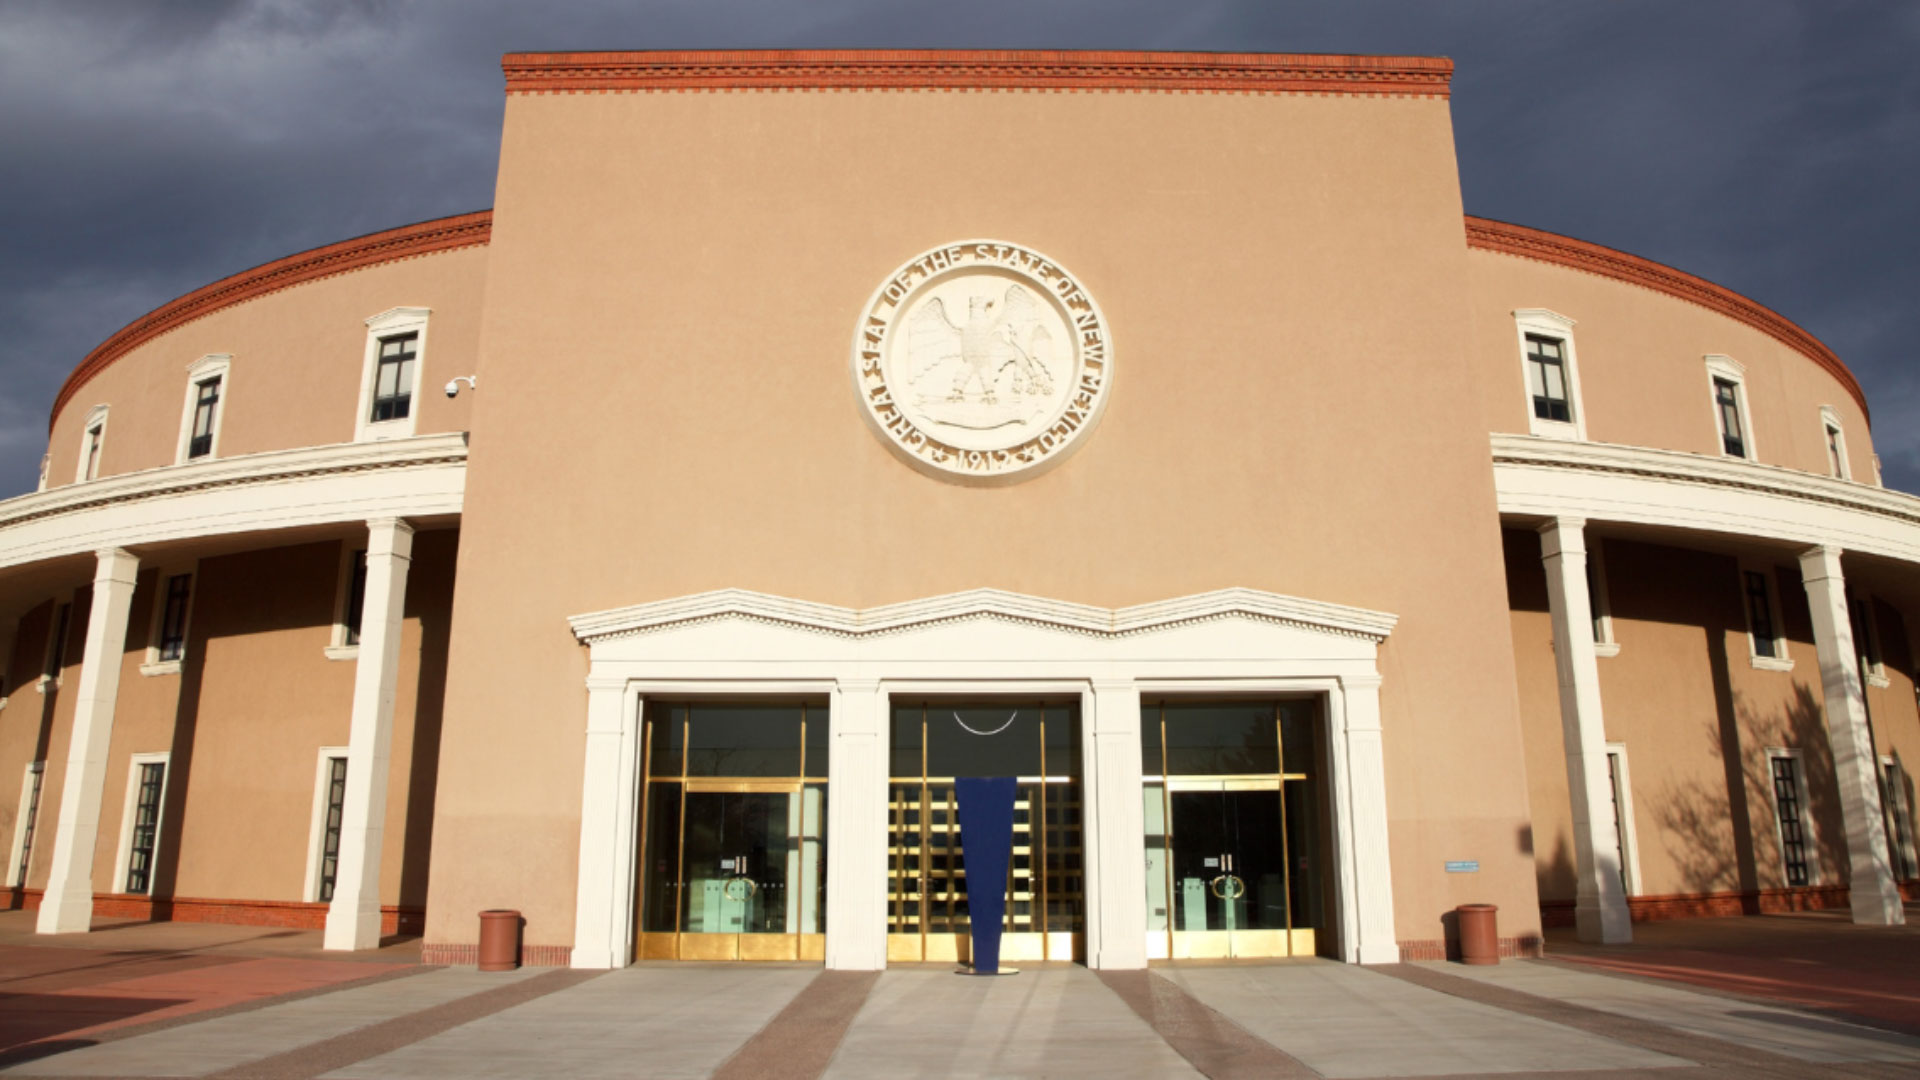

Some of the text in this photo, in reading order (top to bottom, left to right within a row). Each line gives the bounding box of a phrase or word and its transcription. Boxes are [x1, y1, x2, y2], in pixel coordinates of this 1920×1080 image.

[915, 246, 963, 278] THE
[975, 244, 1054, 281] STATE
[885, 271, 912, 301] OF
[1056, 277, 1085, 304] OF
[1076, 310, 1103, 364] NEW
[1040, 373, 1101, 451] MEXICO
[958, 449, 1008, 470] 1912
